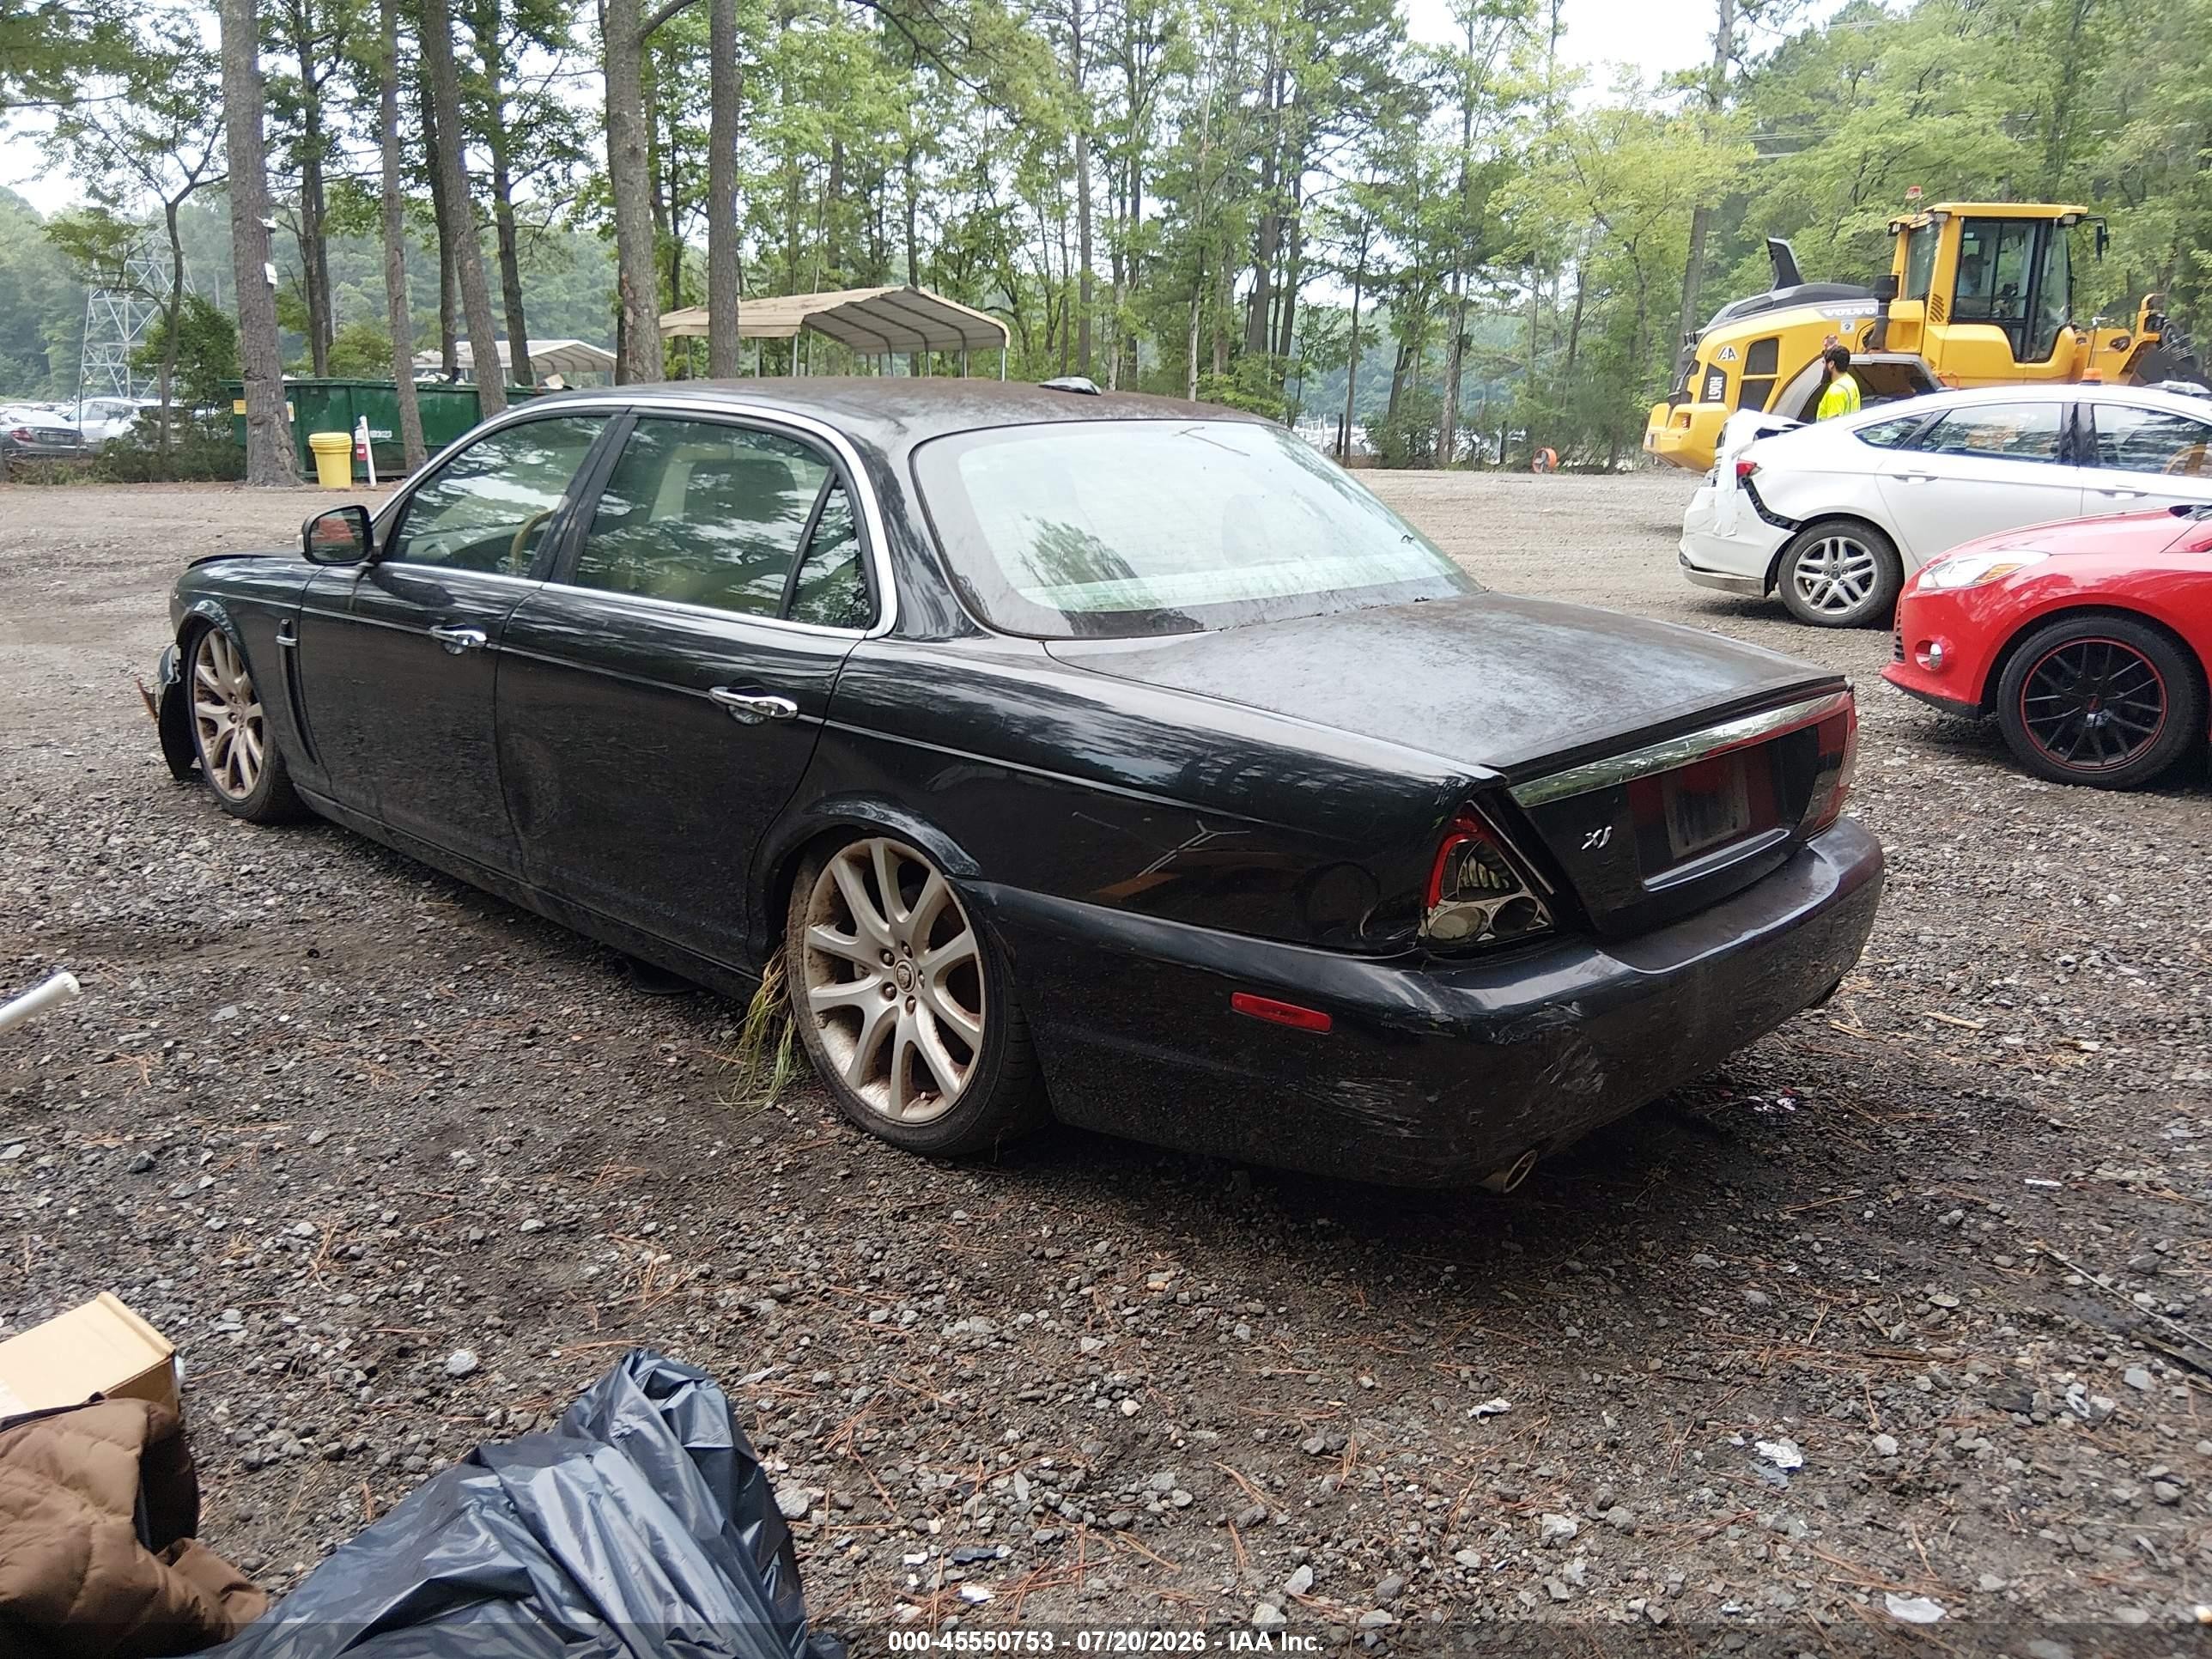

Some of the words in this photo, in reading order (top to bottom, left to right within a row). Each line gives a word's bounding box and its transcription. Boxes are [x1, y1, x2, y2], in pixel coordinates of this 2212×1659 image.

[1821, 307, 1877, 318] VOLVO
[1707, 376, 1724, 400] L90H
[1581, 825, 1613, 850] XJ
